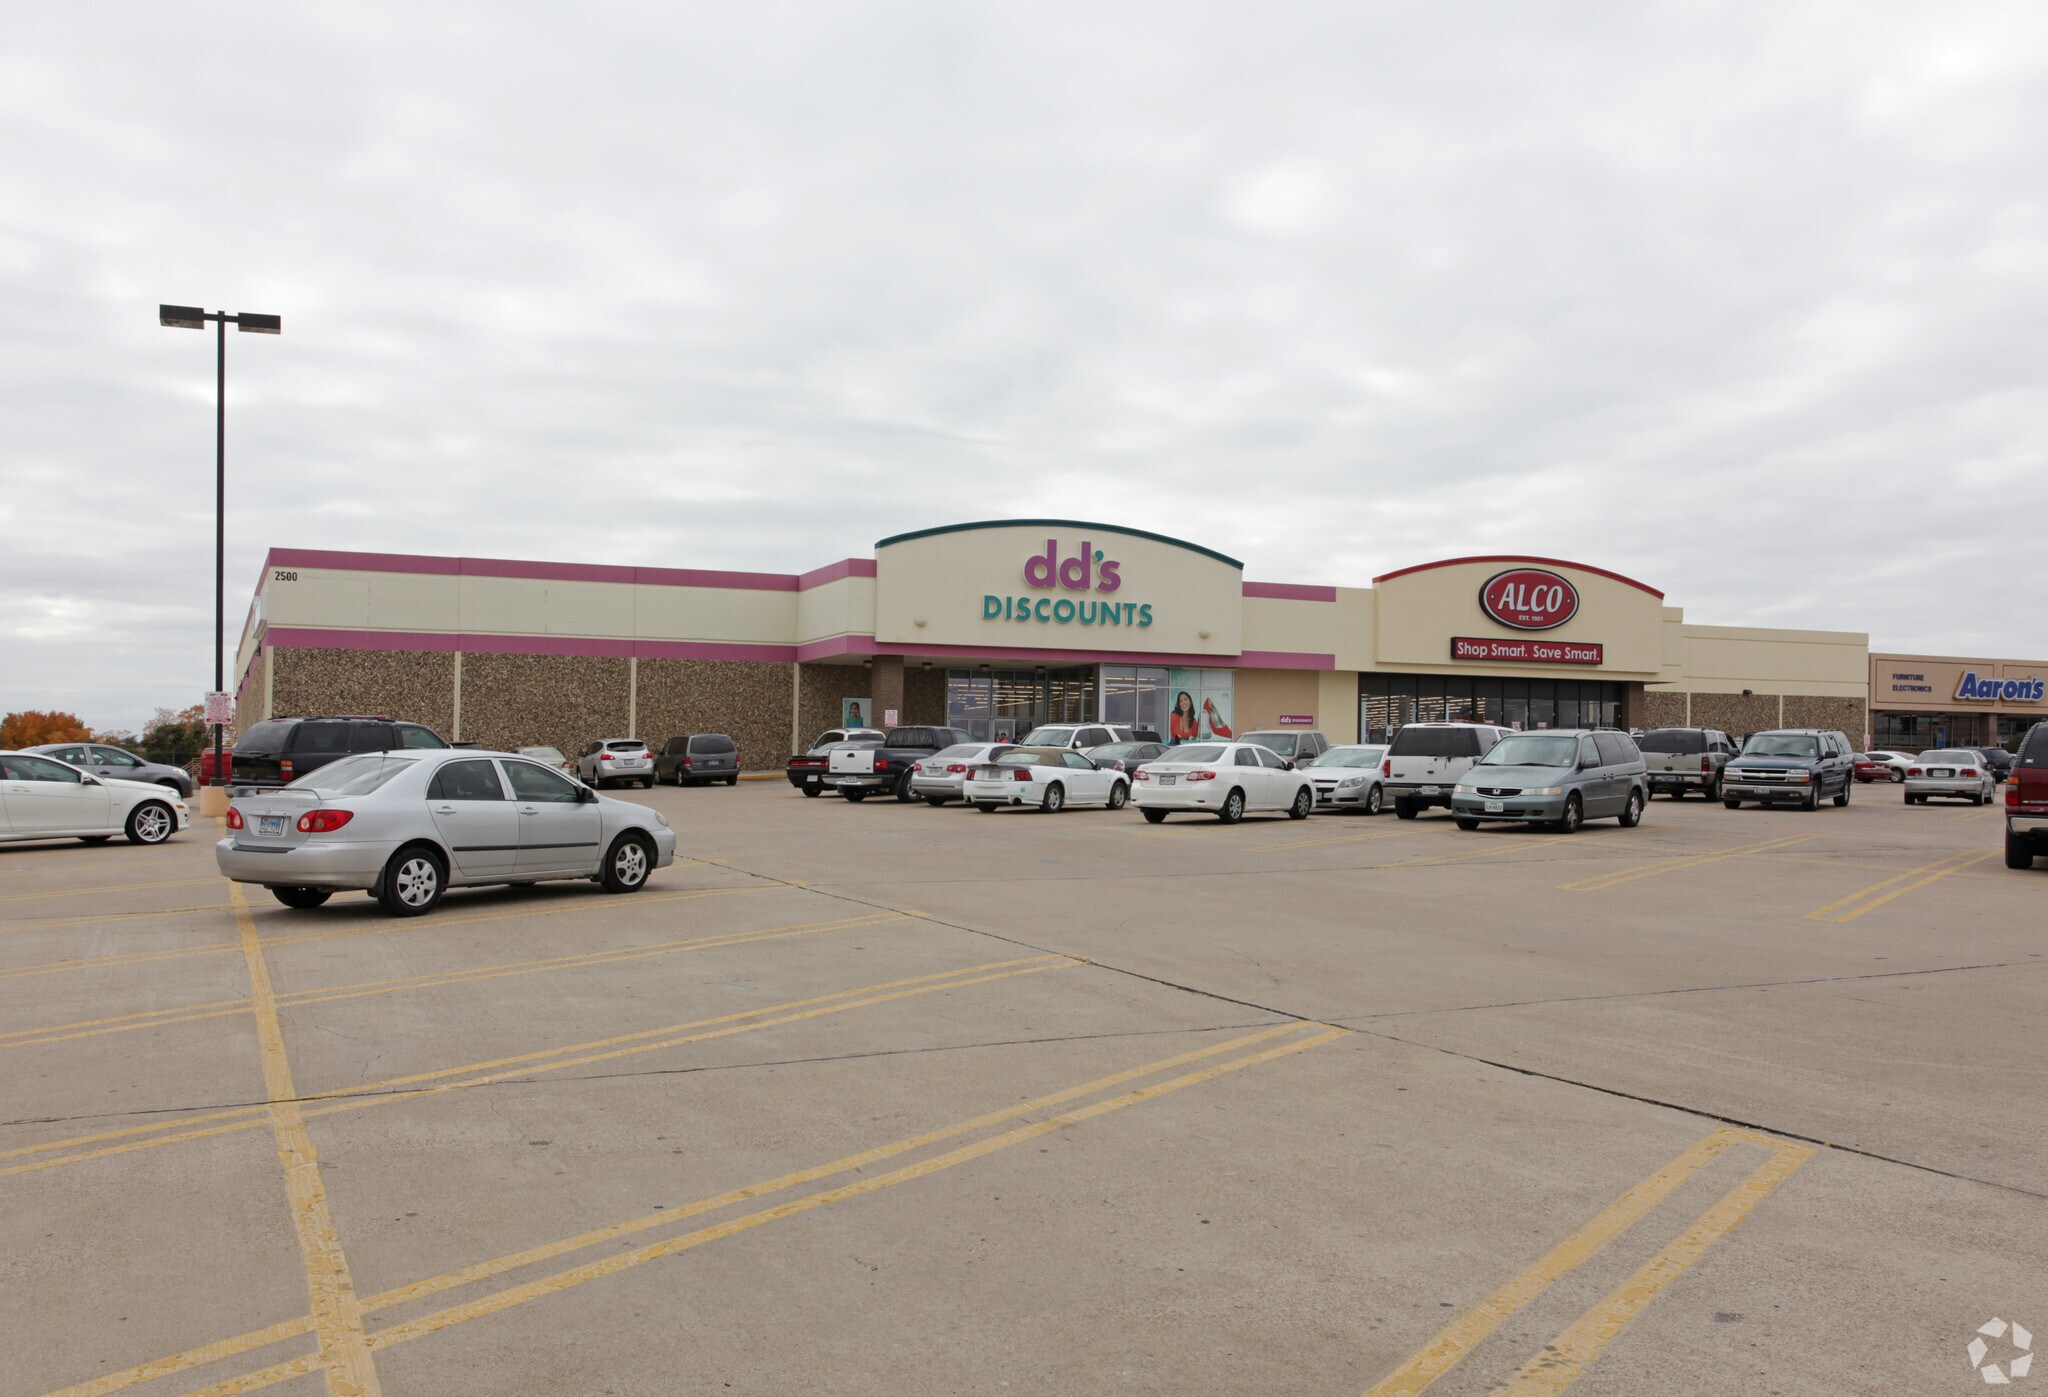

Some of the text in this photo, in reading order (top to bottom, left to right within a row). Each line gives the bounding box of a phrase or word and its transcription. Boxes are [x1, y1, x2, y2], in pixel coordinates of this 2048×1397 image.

[275, 571, 298, 581] 2500
[1024, 538, 1121, 592] dd's
[982, 595, 1153, 627] DISCOUNTS
[1498, 583, 1563, 612] ALCO
[1457, 642, 1600, 661] Shop Smart. Save Smart.
[1892, 673, 1924, 681] FURNITURE
[1957, 672, 2045, 700] Aaron's
